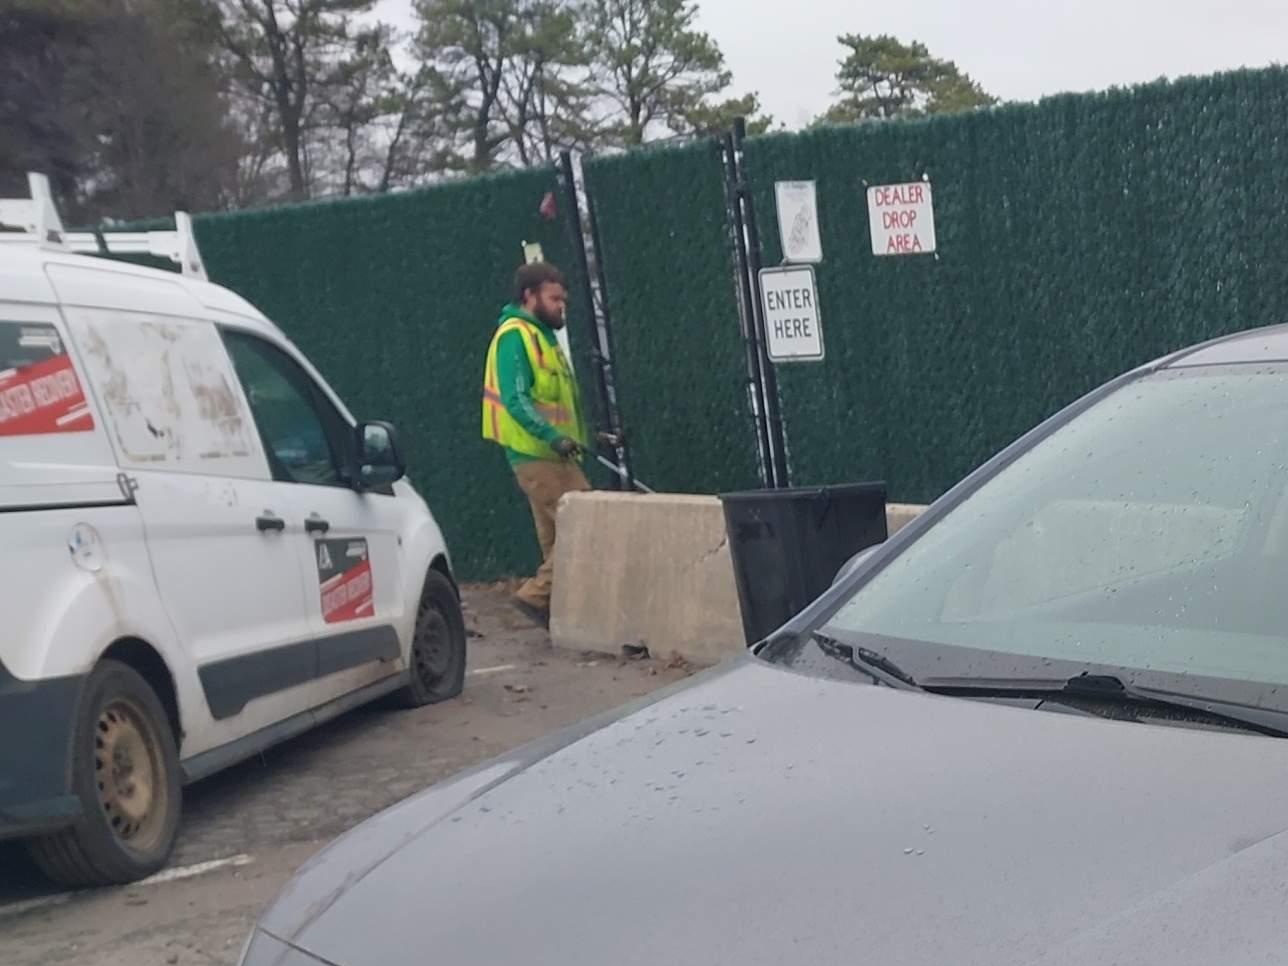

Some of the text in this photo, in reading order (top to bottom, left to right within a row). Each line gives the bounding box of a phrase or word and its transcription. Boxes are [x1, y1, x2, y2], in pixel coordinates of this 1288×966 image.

[874, 185, 924, 206] DEALER
[882, 211, 917, 230] DROP
[886, 234, 923, 252] AREA
[766, 288, 812, 311] ENTER
[774, 318, 812, 339] HERE
